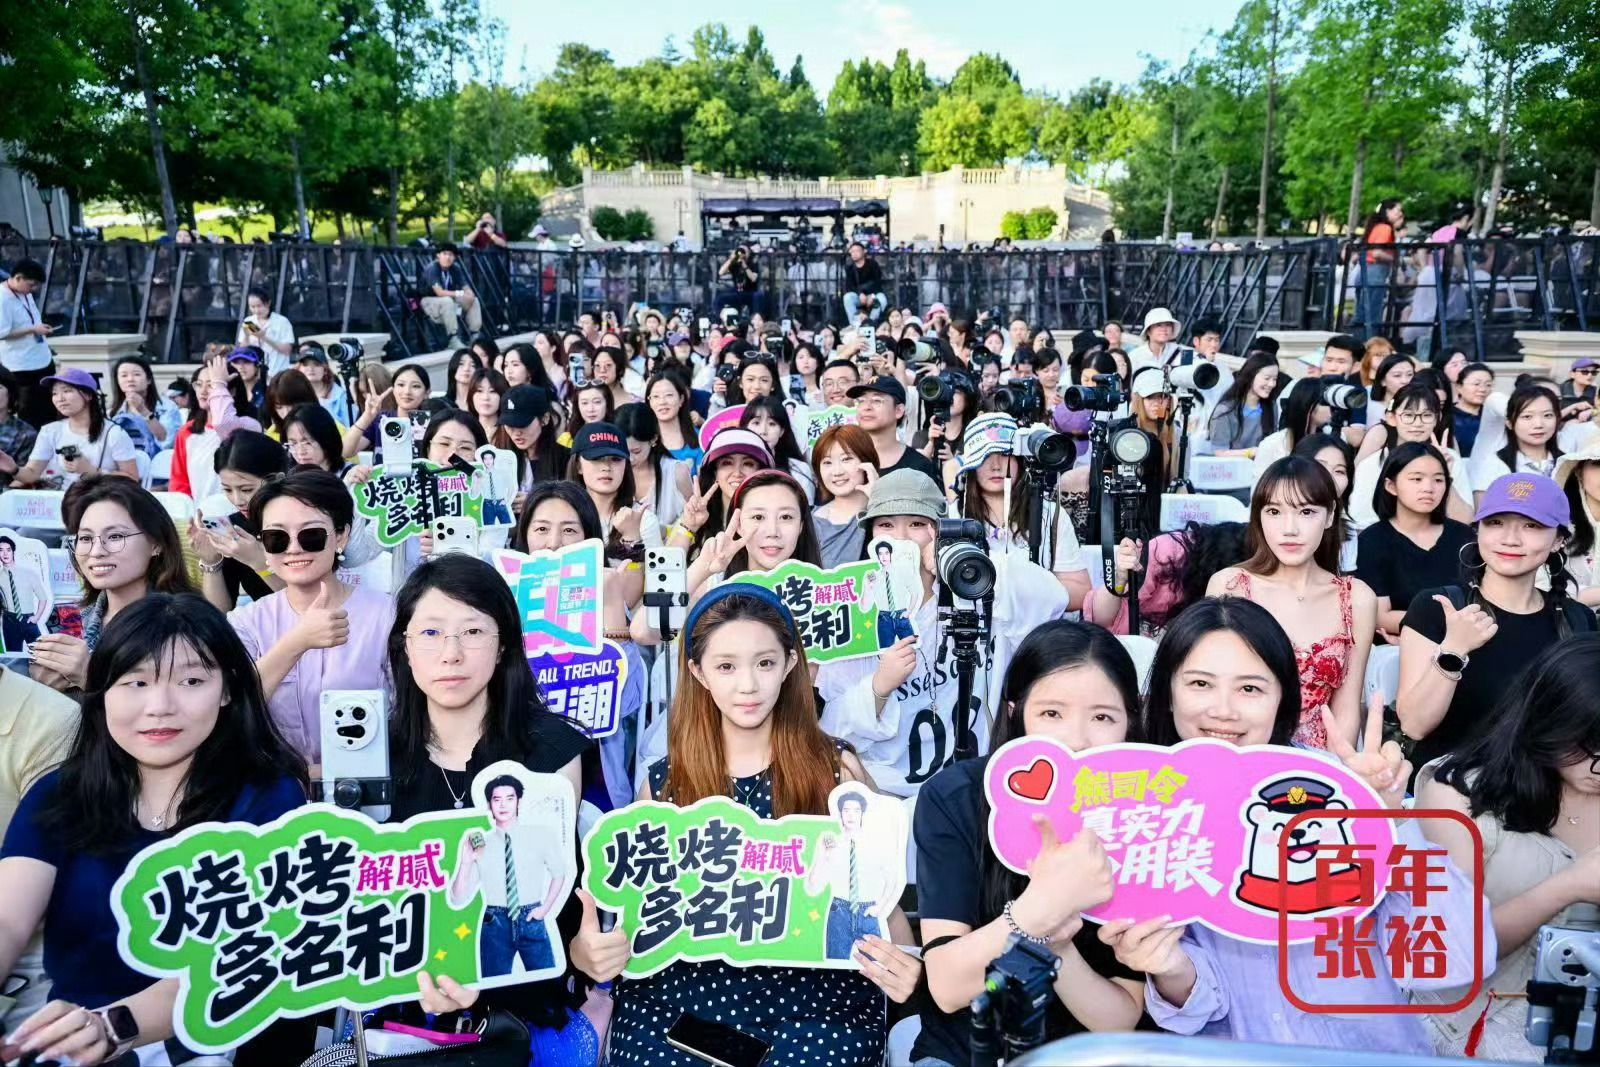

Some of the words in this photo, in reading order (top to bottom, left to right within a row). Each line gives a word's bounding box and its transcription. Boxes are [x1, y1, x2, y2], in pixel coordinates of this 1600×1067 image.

[590, 432, 619, 443] CHINA
[815, 579, 857, 604] 解腻
[1105, 559, 1113, 590] SONY
[538, 667, 558, 684] ALL
[563, 659, 615, 681] TREND.
[1069, 765, 1188, 814] 熊司令
[1081, 798, 1205, 843] 真实力
[357, 843, 445, 891] 解腻
[606, 819, 742, 888] 烧烤
[741, 839, 804, 875] 解腻
[149, 835, 355, 945] 烧烤
[633, 877, 789, 954] 多名利
[211, 896, 427, 1022] 多名利
